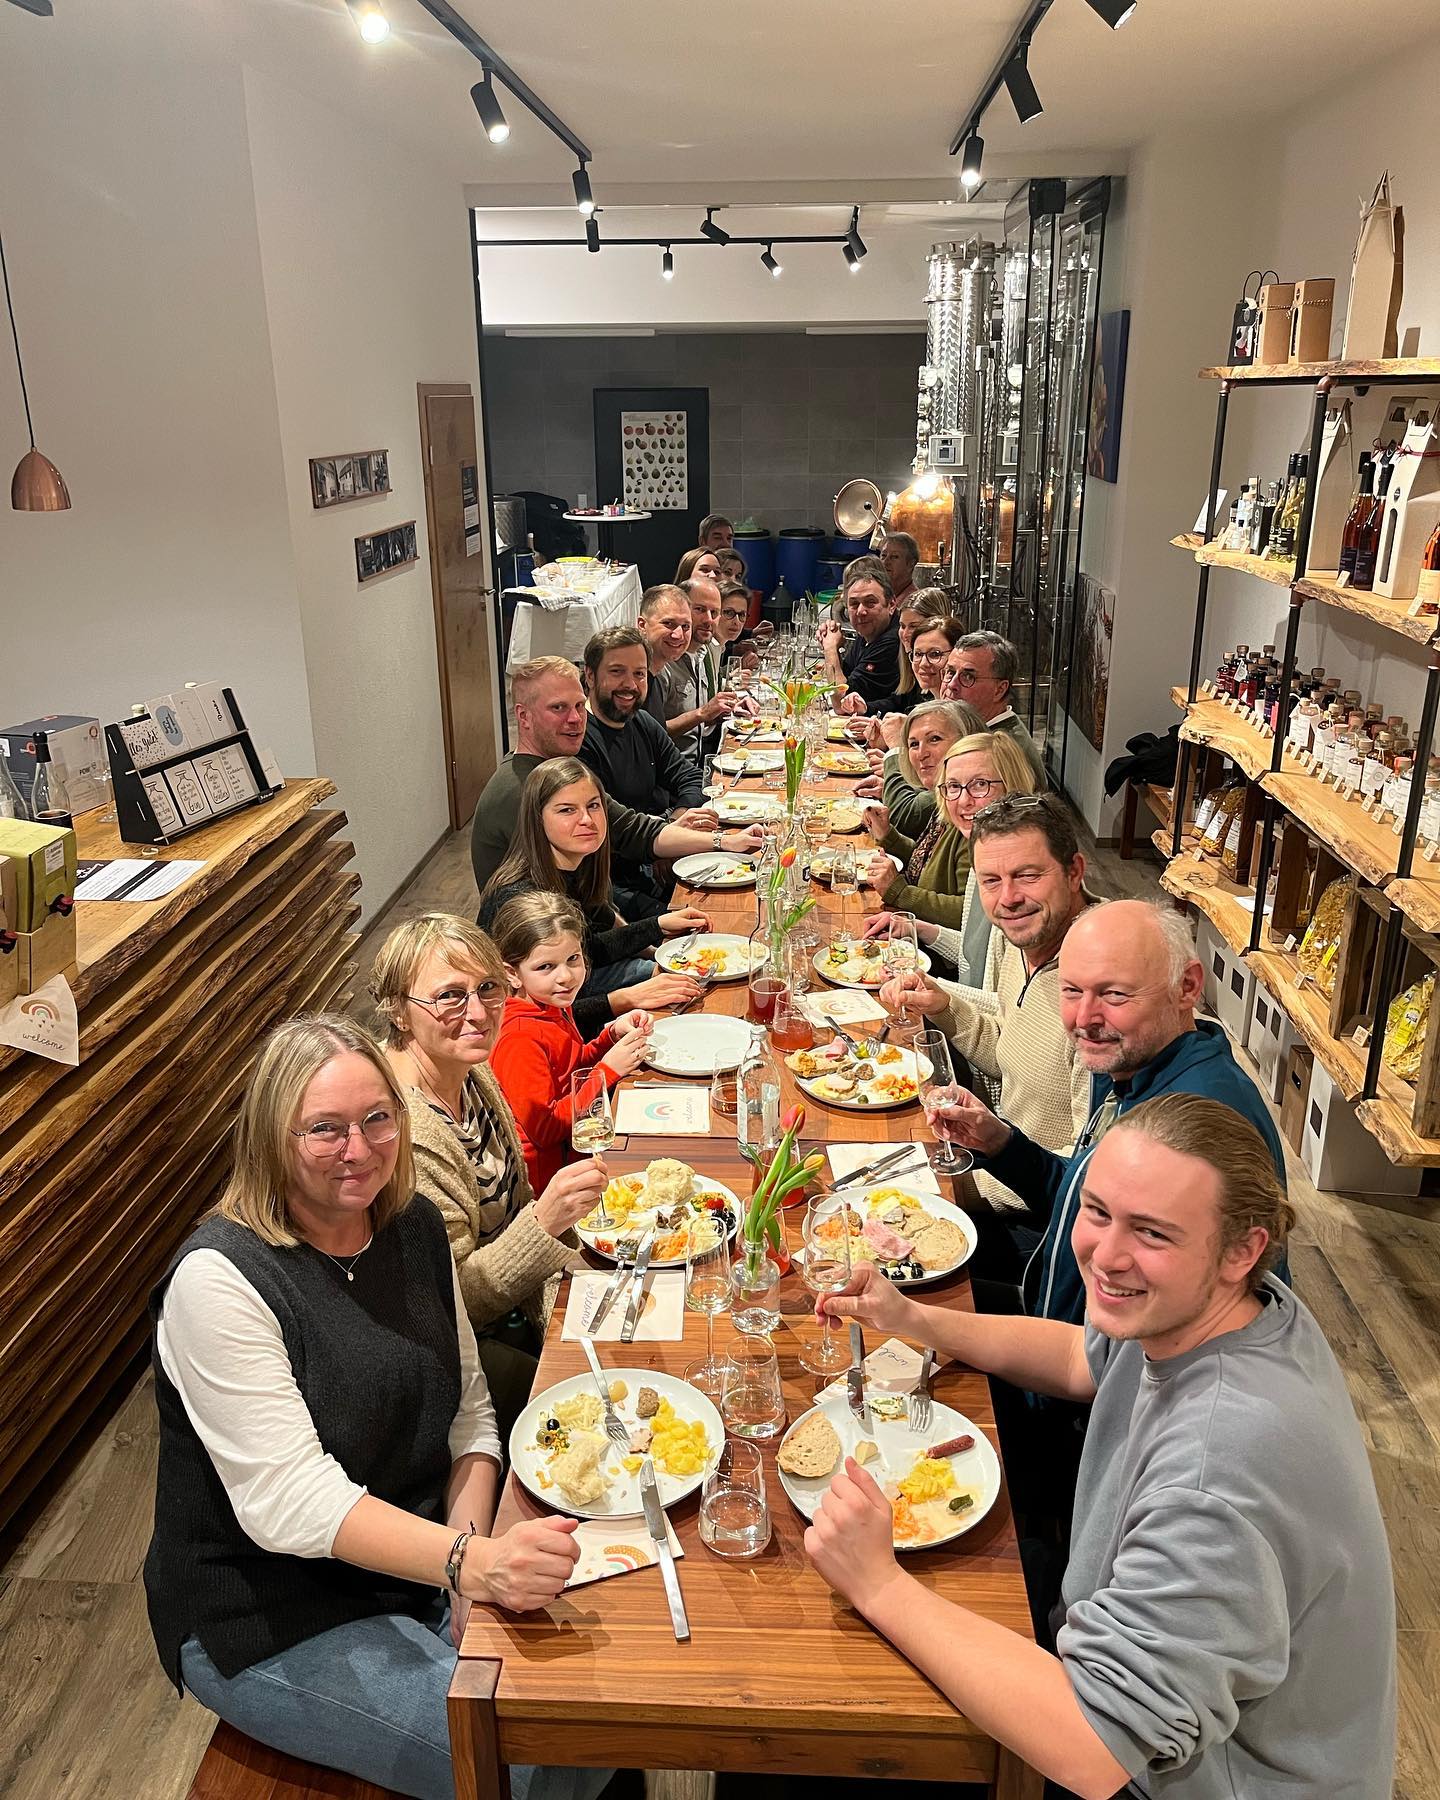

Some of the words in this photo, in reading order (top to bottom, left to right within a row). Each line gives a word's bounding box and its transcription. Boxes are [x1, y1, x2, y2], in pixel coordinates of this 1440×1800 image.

[128, 741, 144, 757] lles
[22, 1032, 66, 1051] welcome
[581, 1281, 599, 1328] welcome
